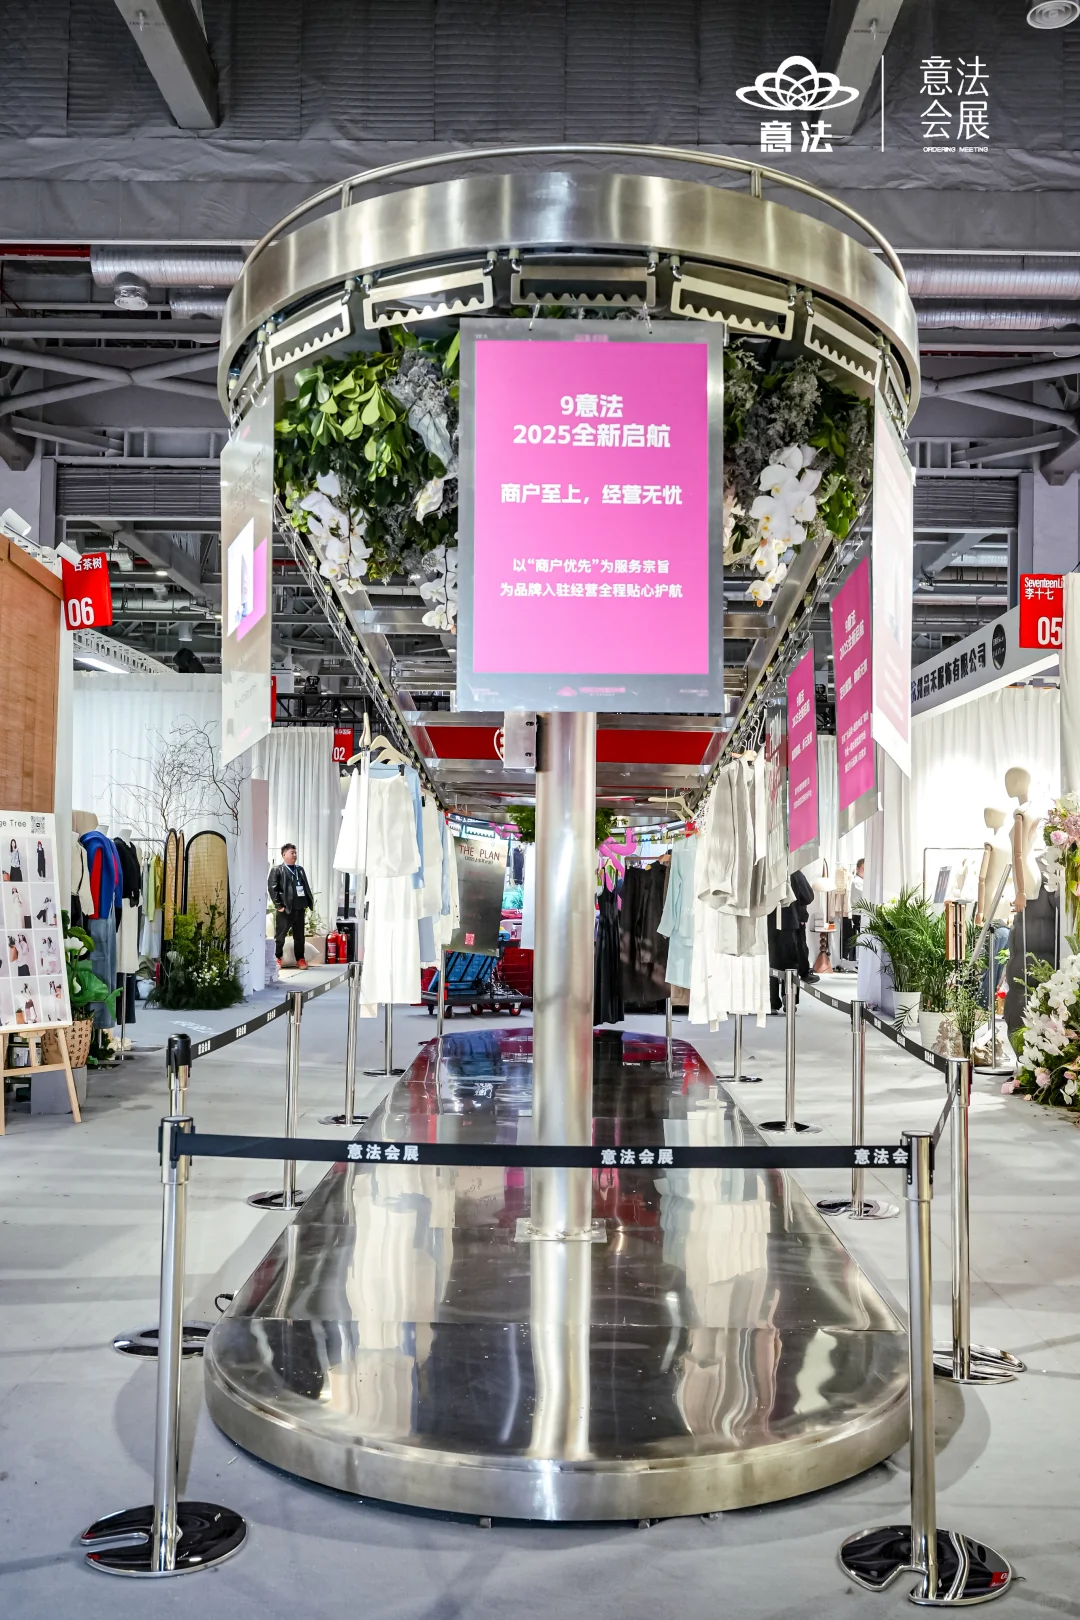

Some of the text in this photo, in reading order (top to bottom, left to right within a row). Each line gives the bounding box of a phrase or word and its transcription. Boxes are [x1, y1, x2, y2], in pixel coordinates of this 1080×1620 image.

[560, 394, 623, 419] 9意法
[512, 423, 671, 448] 2025全新启航
[499, 581, 684, 599] 为品牌入驻经营全程贴心护航
[1024, 588, 1054, 600] 李十七
[67, 597, 95, 627] 06
[1037, 616, 1063, 646] 05
[333, 747, 346, 761] 02
[9, 819, 27, 828] Tree
[459, 844, 500, 861] THE PLAN
[346, 1143, 909, 1165] 意法会展 意法会展 意法会
